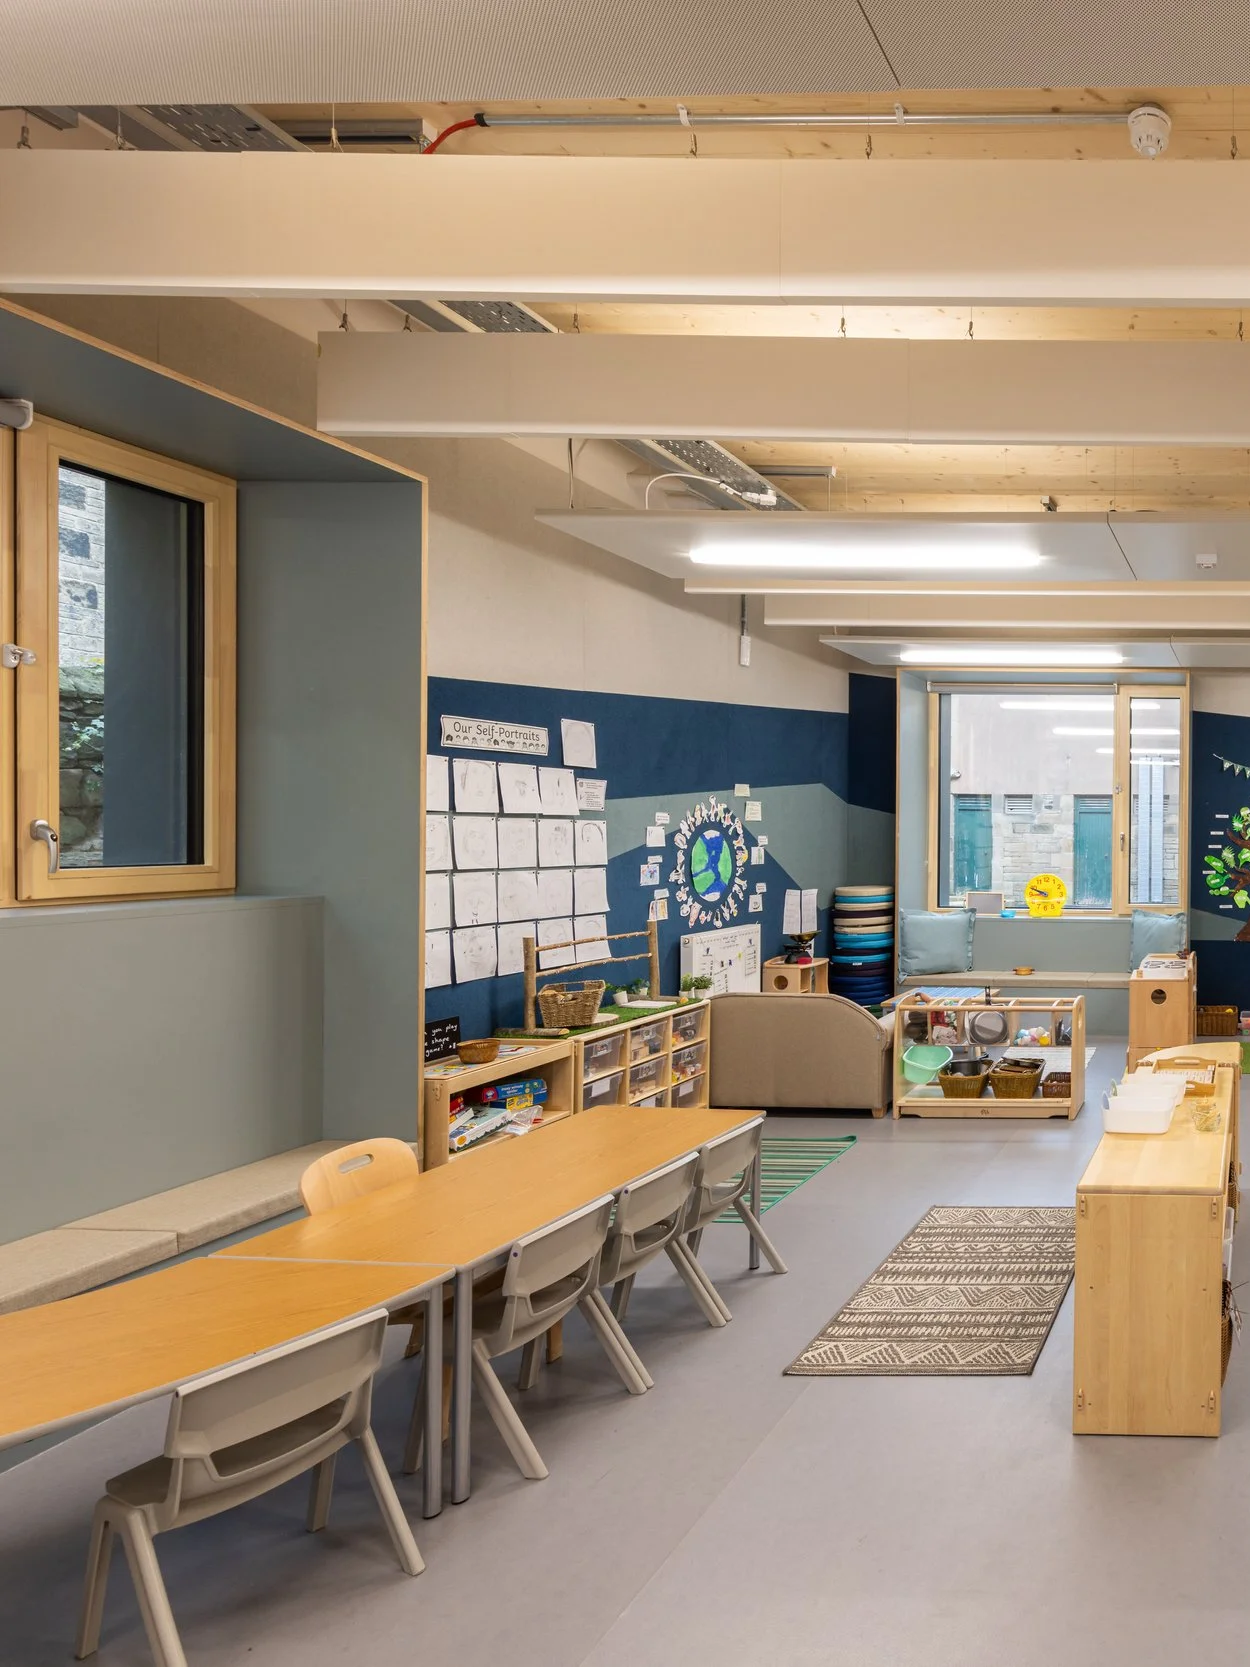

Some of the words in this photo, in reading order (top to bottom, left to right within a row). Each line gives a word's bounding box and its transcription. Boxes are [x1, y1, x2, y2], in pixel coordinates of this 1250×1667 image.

[453, 722, 472, 734] Our
[476, 724, 540, 741] Self-Portraits
[431, 1028, 442, 1037] you
[445, 1024, 457, 1033] play
[431, 1037, 450, 1045] shape
